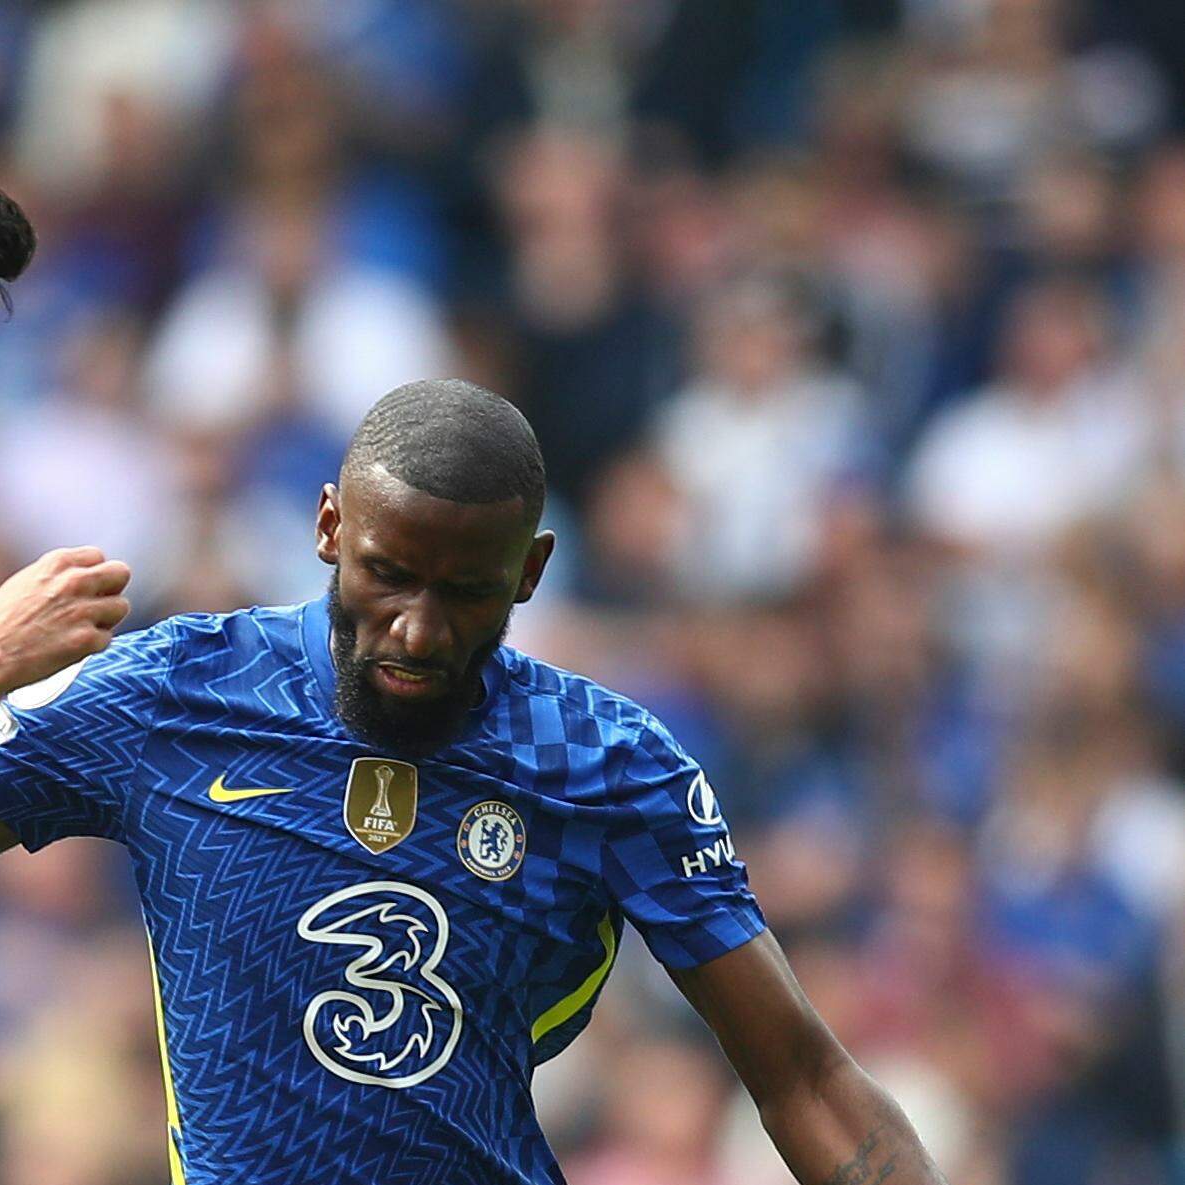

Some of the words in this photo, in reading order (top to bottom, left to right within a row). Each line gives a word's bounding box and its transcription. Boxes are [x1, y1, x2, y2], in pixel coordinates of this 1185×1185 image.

[364, 816, 396, 832] FIFA
[474, 804, 518, 826] CHELSEA
[297, 880, 463, 1088] 3
